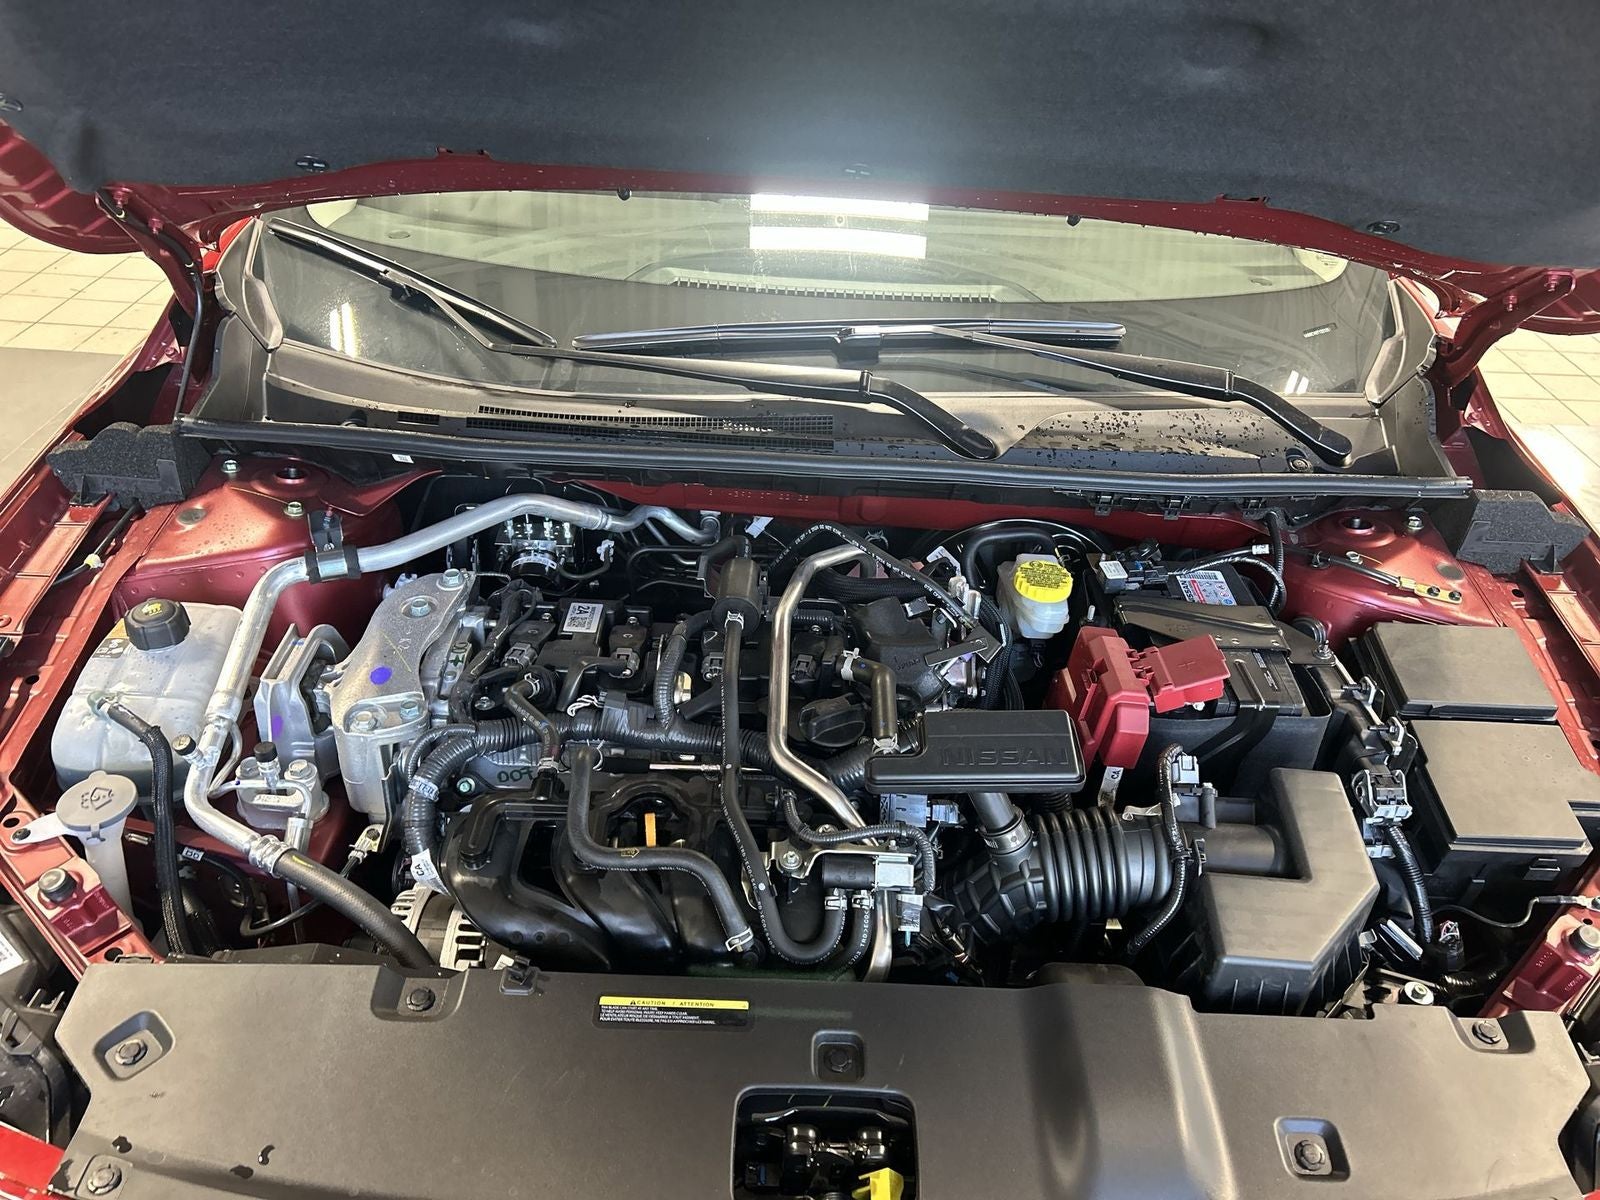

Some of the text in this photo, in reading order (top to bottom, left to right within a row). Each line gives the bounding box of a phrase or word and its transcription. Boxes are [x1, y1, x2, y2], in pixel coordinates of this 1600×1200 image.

[576, 605, 590, 615] 2A
[943, 748, 1069, 767] NISSAN
[414, 863, 425, 877] CA
